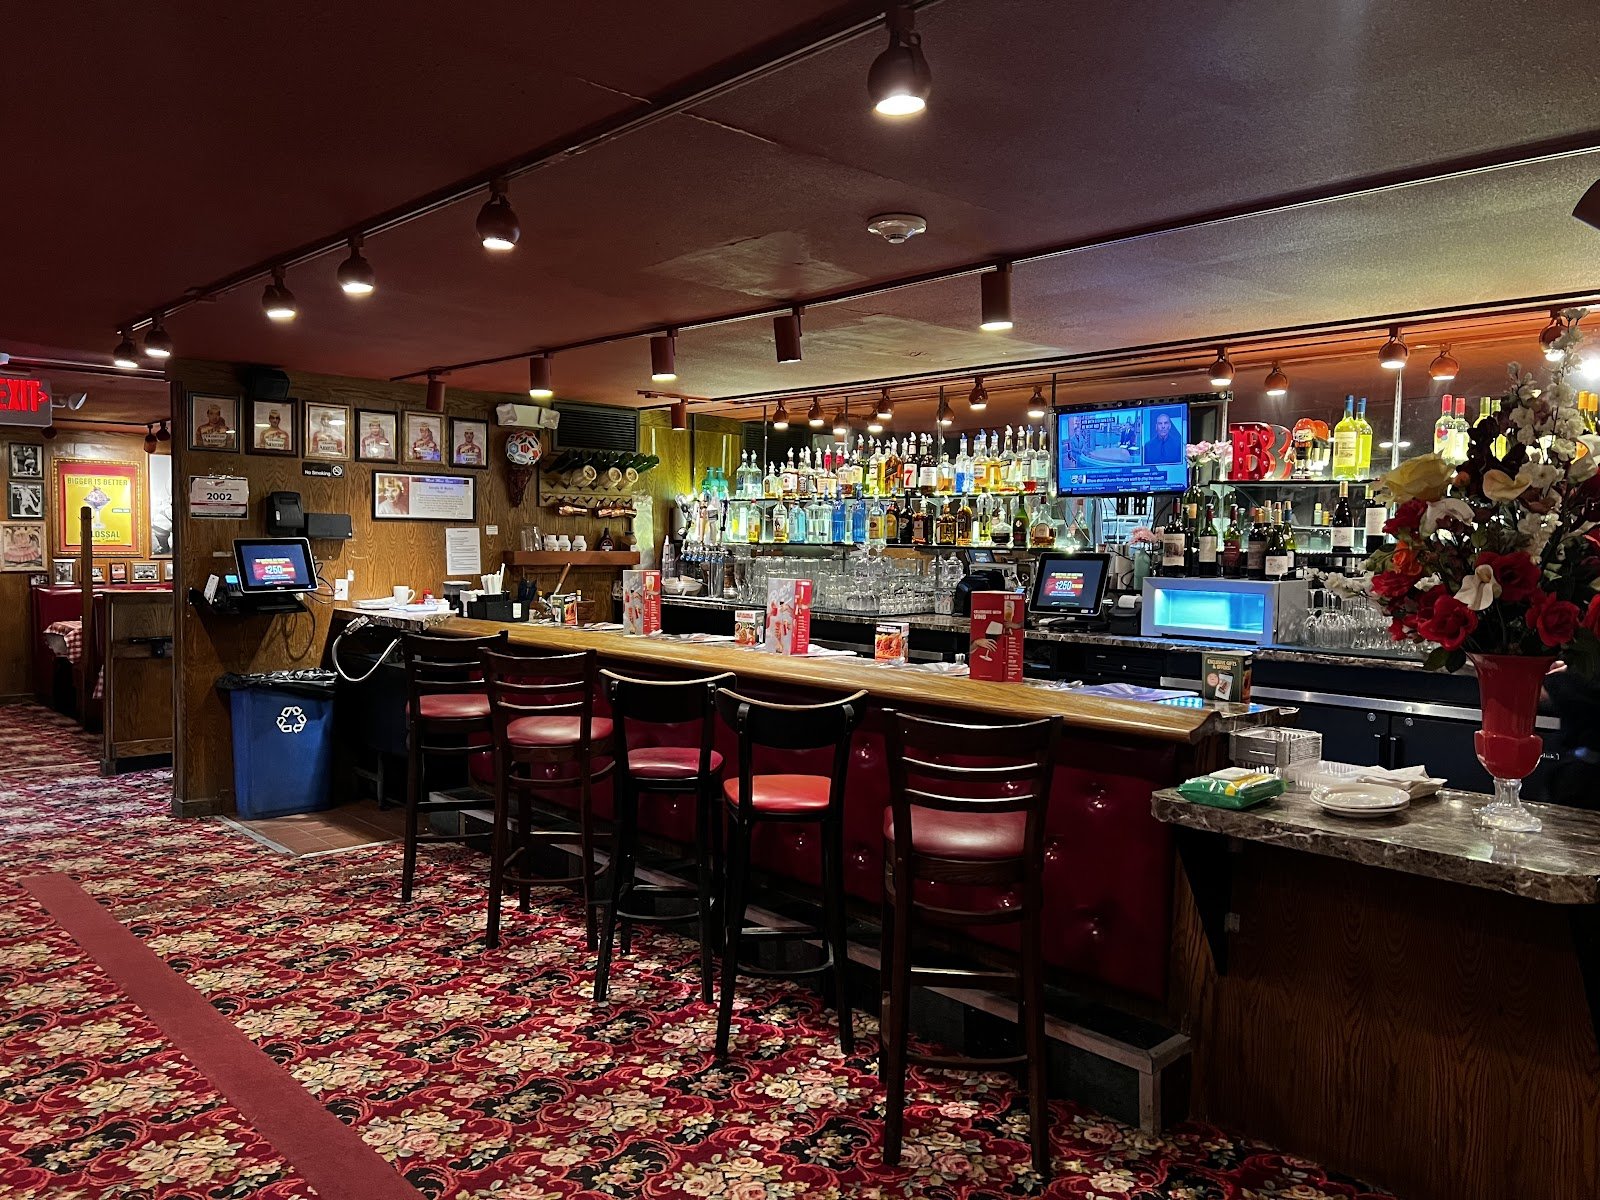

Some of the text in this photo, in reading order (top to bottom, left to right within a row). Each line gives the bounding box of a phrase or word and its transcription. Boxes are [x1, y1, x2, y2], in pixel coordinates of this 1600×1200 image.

[0, 378, 40, 412] EXIT
[1228, 421, 1276, 481] B
[67, 477, 92, 485] BIGGER
[103, 478, 128, 486] BETTER
[905, 469, 914, 486] 7
[206, 492, 232, 501] 2002
[80, 530, 120, 538] LOSSAL
[264, 564, 283, 575] $250
[1055, 580, 1073, 591] $250
